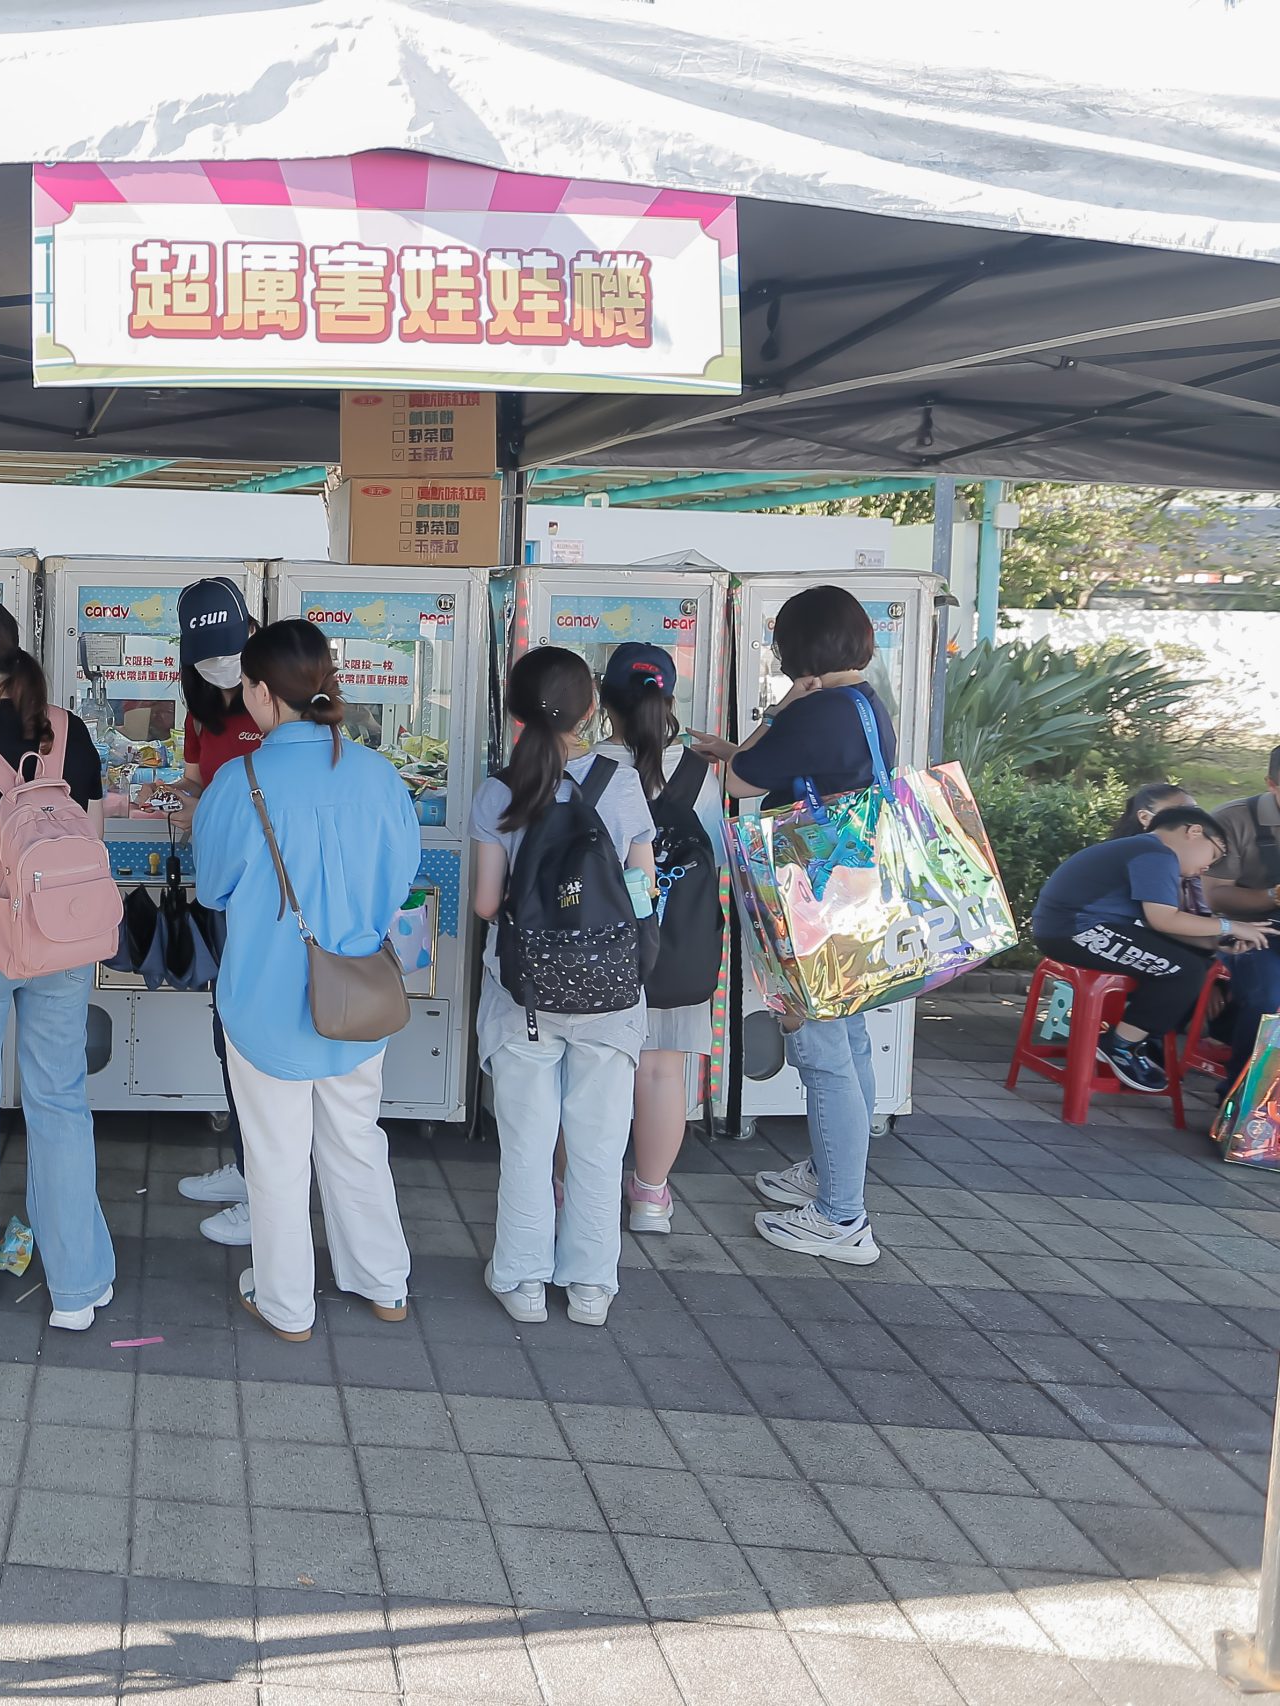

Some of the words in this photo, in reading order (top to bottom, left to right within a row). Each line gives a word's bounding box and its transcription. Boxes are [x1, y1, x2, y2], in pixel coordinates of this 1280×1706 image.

[128, 239, 653, 348] 超厲害娃娃機
[408, 428, 454, 443] 野菜園
[415, 520, 459, 535] 野菜園
[85, 605, 130, 619] candy
[199, 610, 228, 627] sun
[307, 610, 352, 624] candy
[420, 612, 454, 625] bear
[557, 615, 600, 629] candy
[663, 617, 695, 630] bear
[872, 619, 903, 632] bear
[884, 895, 1001, 966] G2C+
